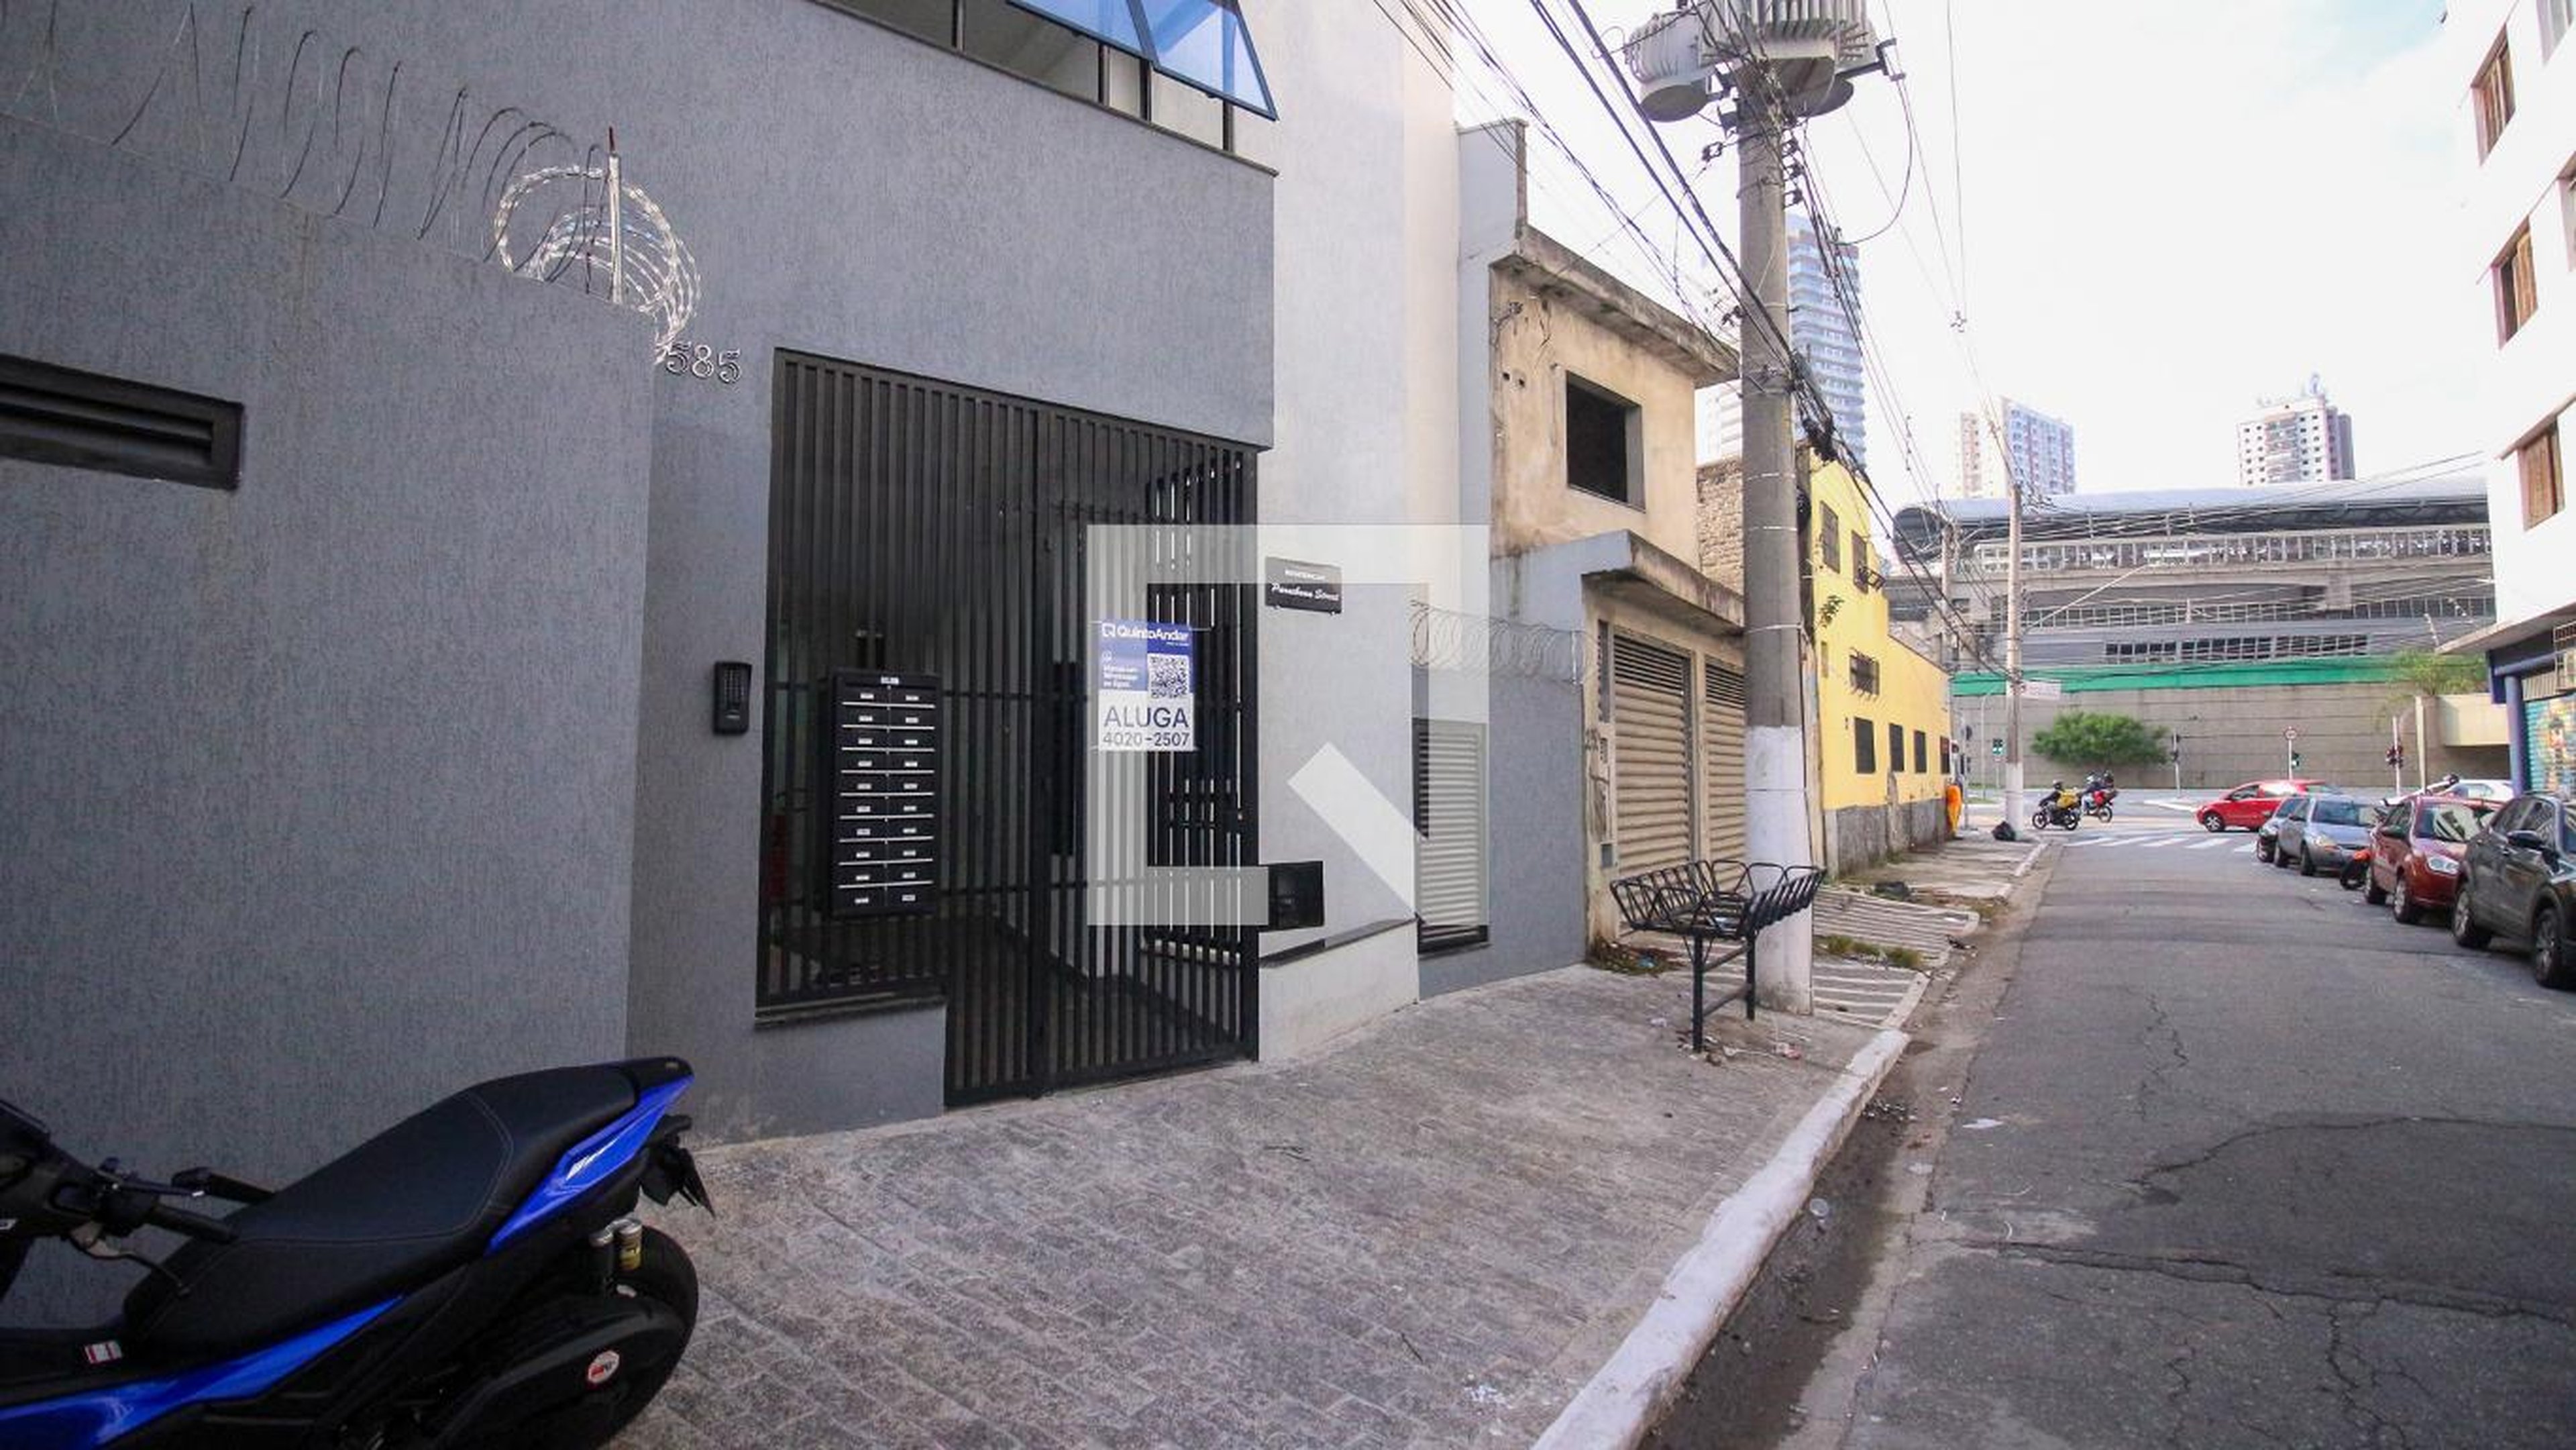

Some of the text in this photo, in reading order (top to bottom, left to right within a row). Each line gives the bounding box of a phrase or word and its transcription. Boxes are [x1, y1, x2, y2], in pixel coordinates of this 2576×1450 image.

[666, 341, 742, 384] 585
[1117, 625, 1189, 641] QuintoAndar
[1104, 707, 1189, 729] ALUGA
[1103, 731, 1190, 748] 4020-2507
